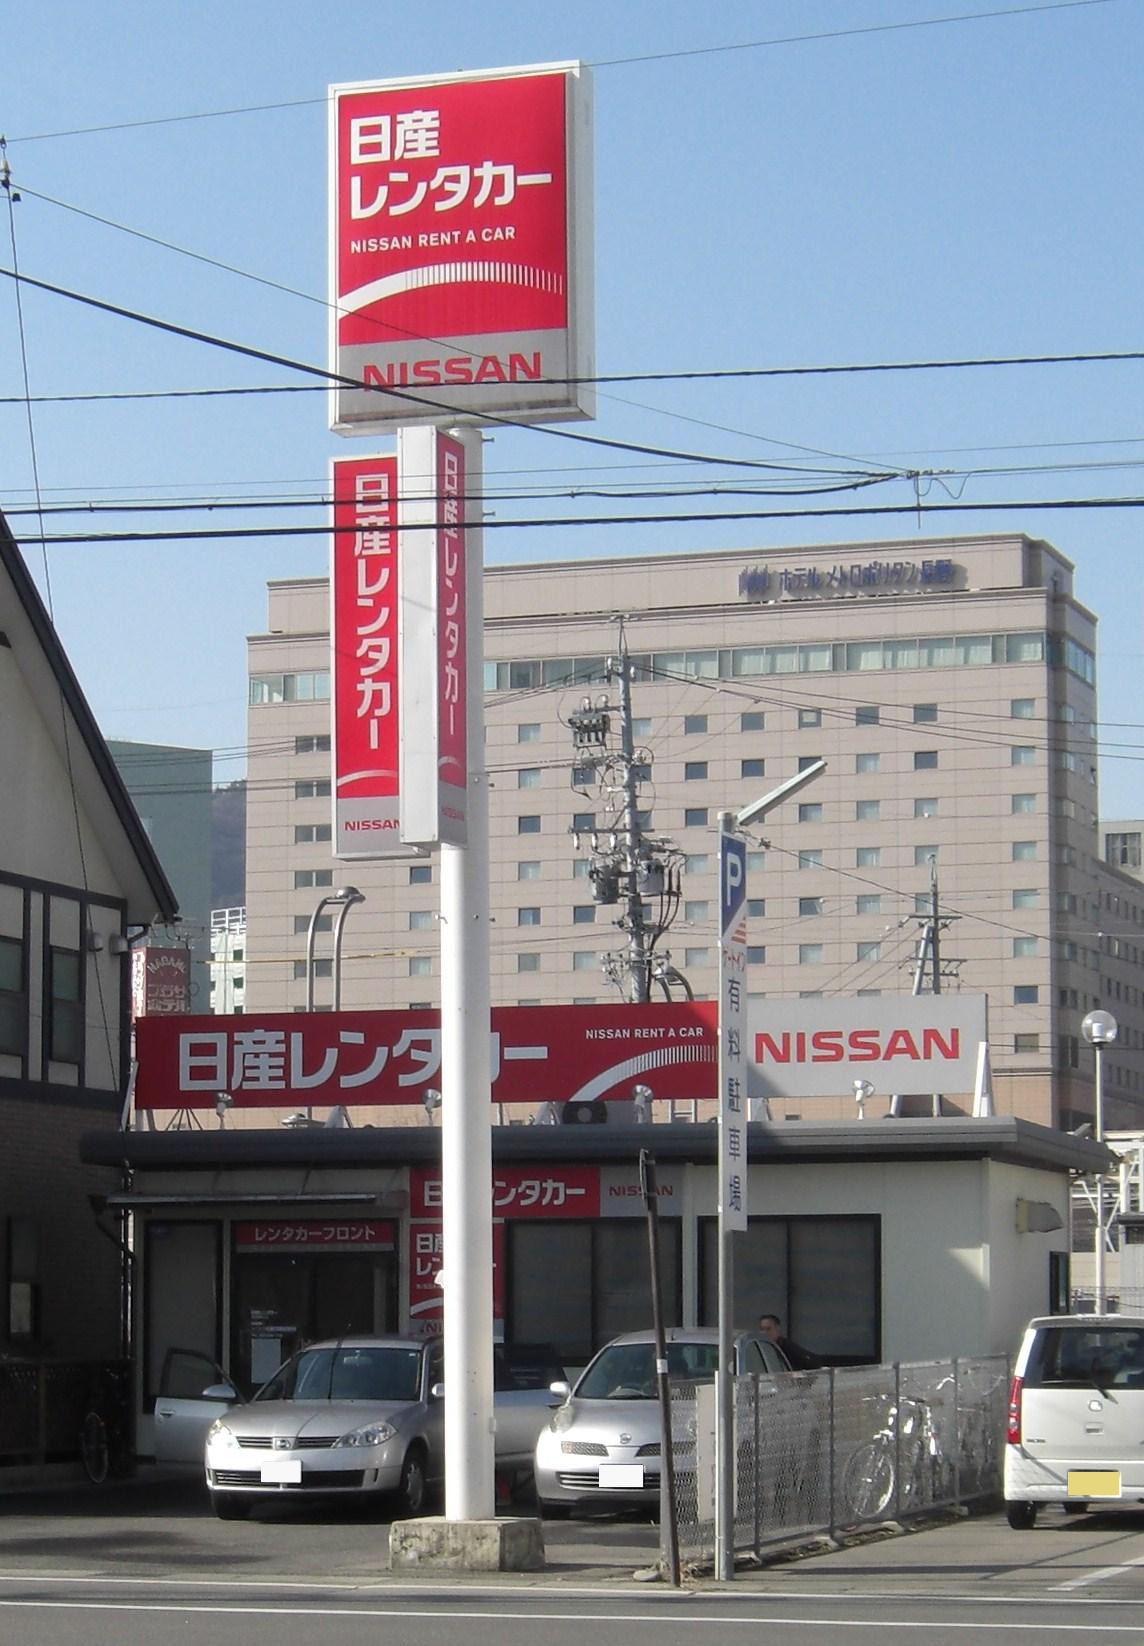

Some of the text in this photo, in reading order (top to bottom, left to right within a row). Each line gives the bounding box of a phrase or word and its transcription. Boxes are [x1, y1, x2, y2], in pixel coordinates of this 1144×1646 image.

[351, 110, 440, 164] 日産
[351, 161, 552, 220] レンタカー
[350, 226, 515, 254] NISSAN RENT A CAR
[363, 352, 541, 391] NISSAN
[354, 473, 391, 750] 日産レンタカー
[445, 451, 459, 736] 日産レンタカー
[727, 852, 742, 907] P
[585, 1026, 704, 1040] NISSAN RENT A CAR
[754, 1028, 960, 1064] NISSAN
[180, 1029, 548, 1092] 日産レンター
[424, 1179, 585, 1206] 日ンタカー
[609, 1184, 673, 1197] NISN
[255, 1225, 375, 1241] レンタカーフロント
